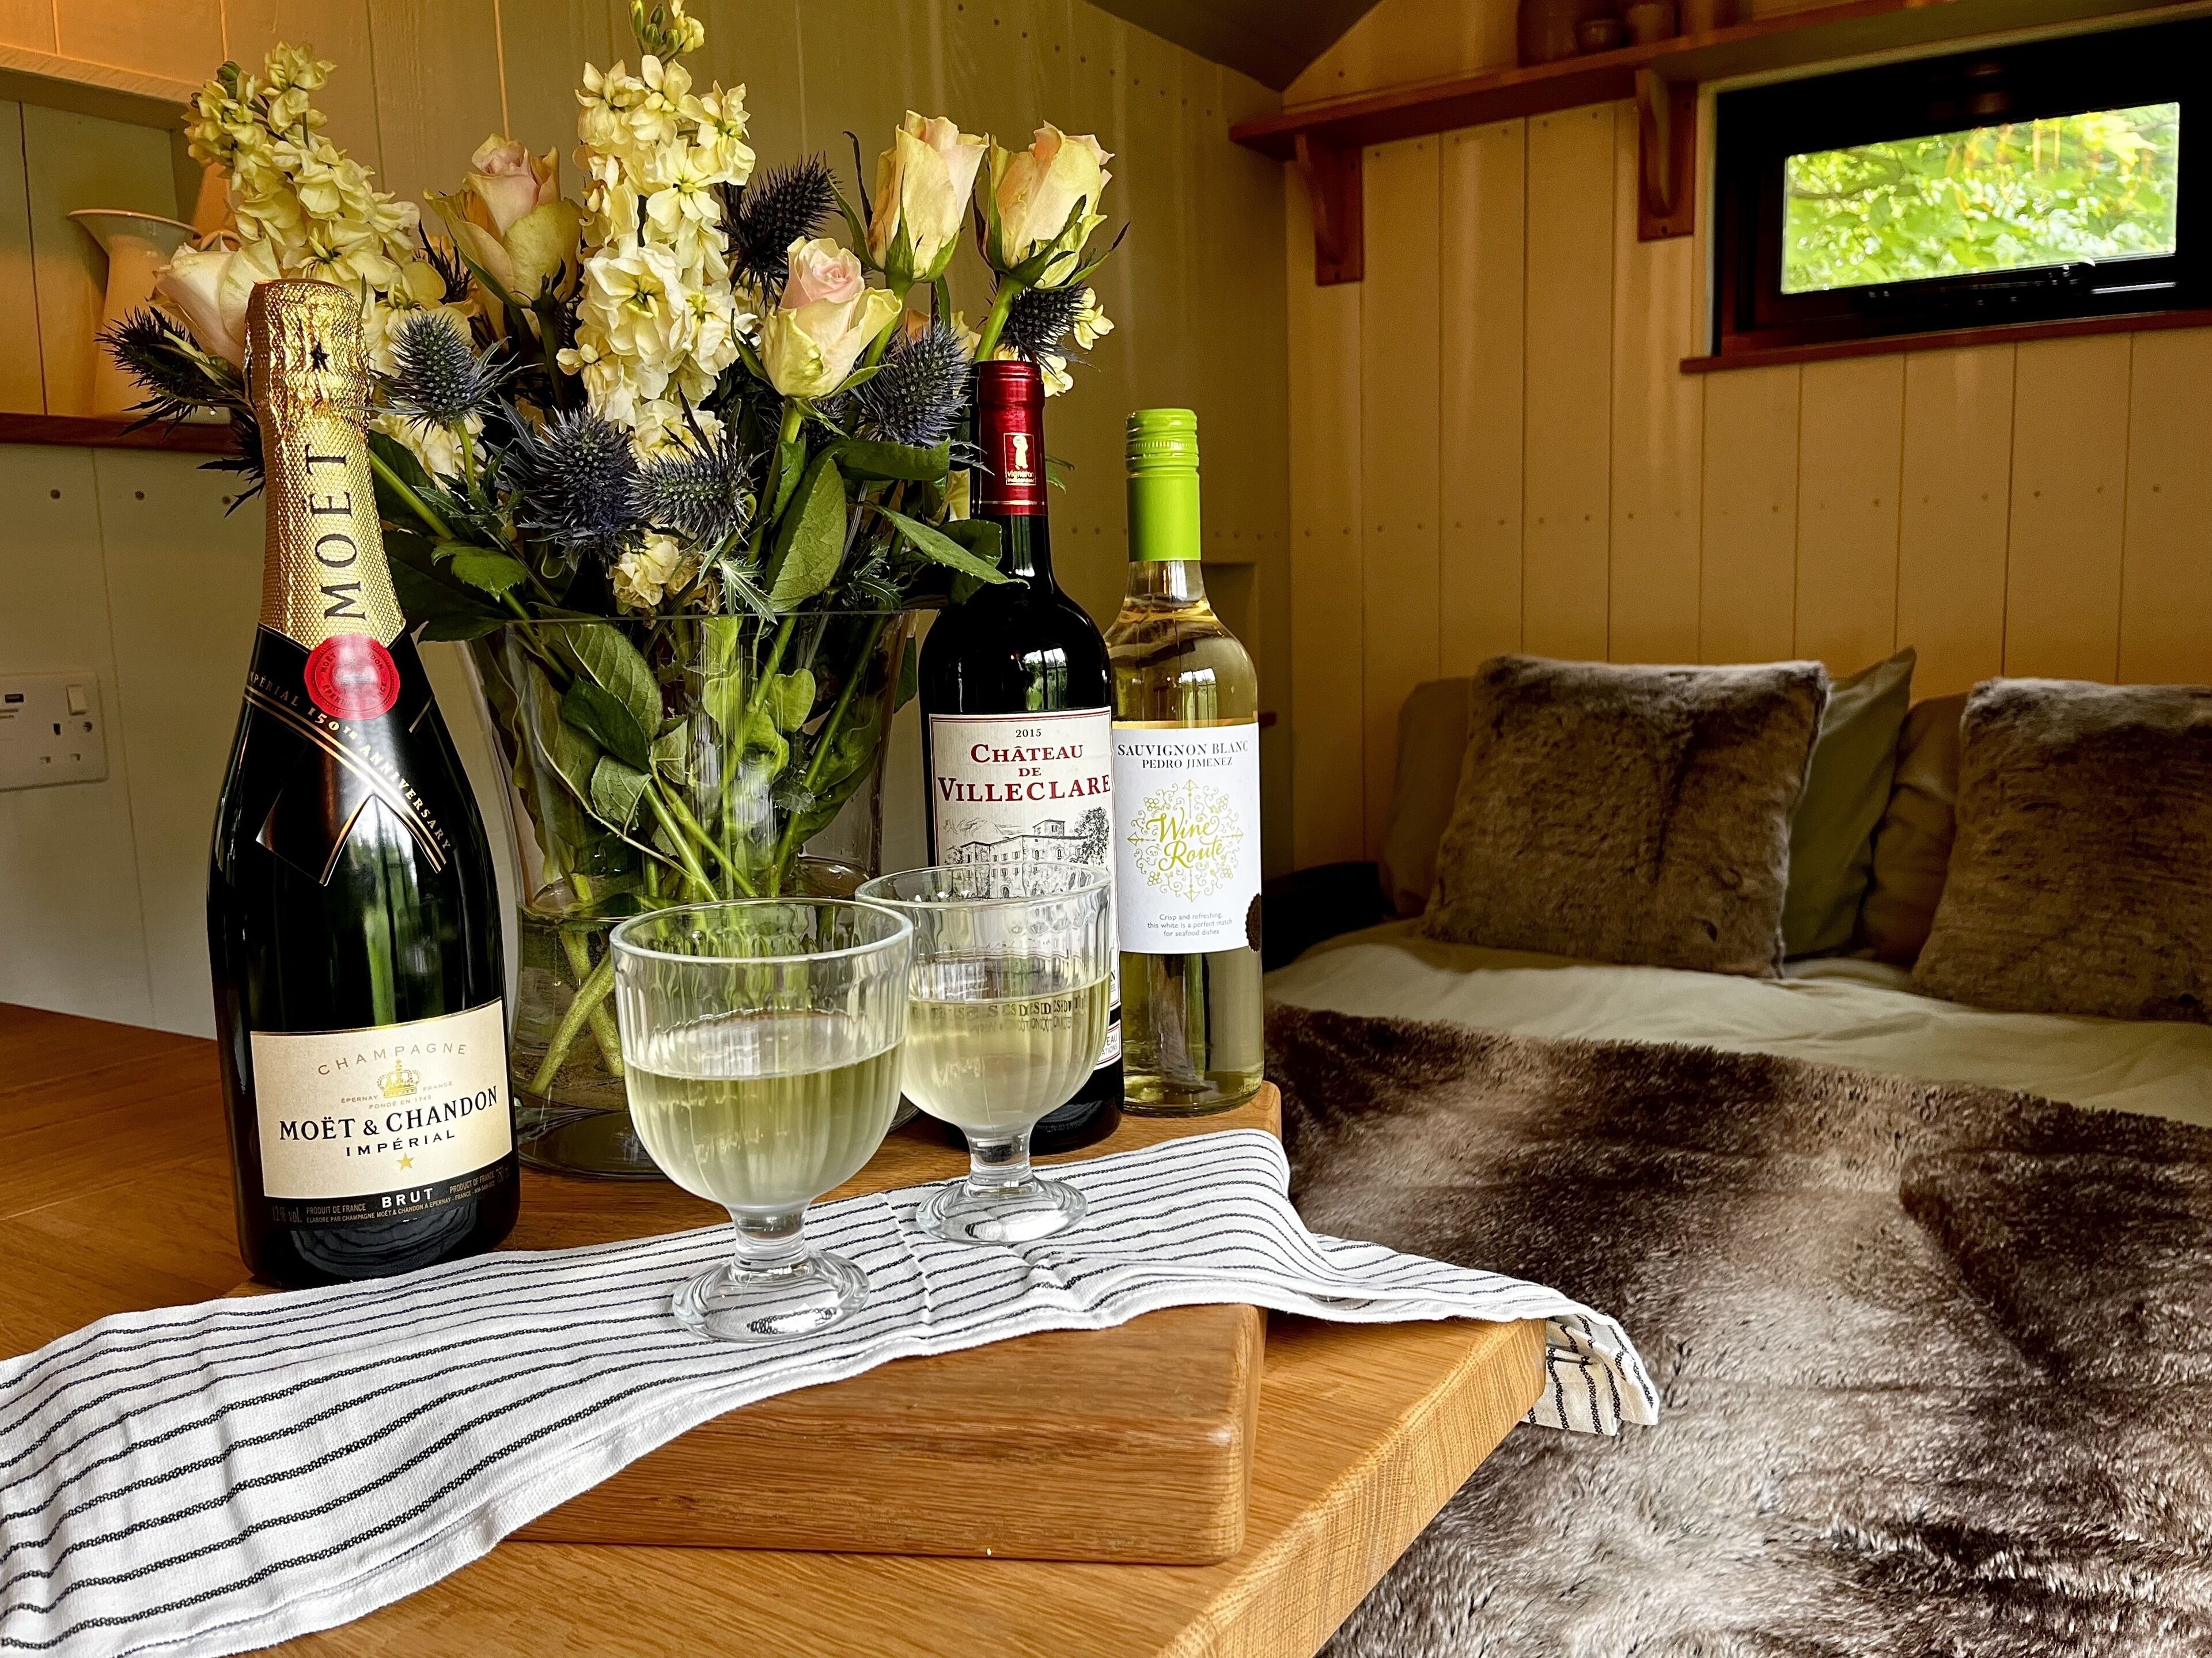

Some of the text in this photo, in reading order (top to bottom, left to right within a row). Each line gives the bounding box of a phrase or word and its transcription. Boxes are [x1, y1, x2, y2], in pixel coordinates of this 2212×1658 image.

[1016, 729, 1041, 738] 2015
[1118, 740, 1249, 756] SAUVIGNON BLANC
[1018, 767, 1041, 777] DE
[1142, 756, 1233, 769] PEDRO JIMENEZ
[359, 744, 451, 849] ANNIVERSARY
[937, 774, 1111, 802] VILLECLARE
[1146, 807, 1220, 843] Wine
[1158, 835, 1225, 871] Route
[1193, 920, 1215, 929] perfect
[318, 1042, 467, 1076] CHAMPAGNE
[422, 1080, 453, 1092] FRANCE
[279, 1085, 498, 1140] MOËT & CHANDON
[346, 1130, 456, 1157] IMPÉRIAL
[306, 1206, 331, 1215] PRODUIT
[332, 1205, 341, 1214] DE
[342, 1203, 366, 1213] FRANCE
[449, 1179, 472, 1194] PRODUCT
[472, 1177, 479, 1186] OF
[381, 1187, 433, 1208] BRUT
[342, 1212, 375, 1221] CHAMPAGNE
[398, 1204, 423, 1215] CHANDON
